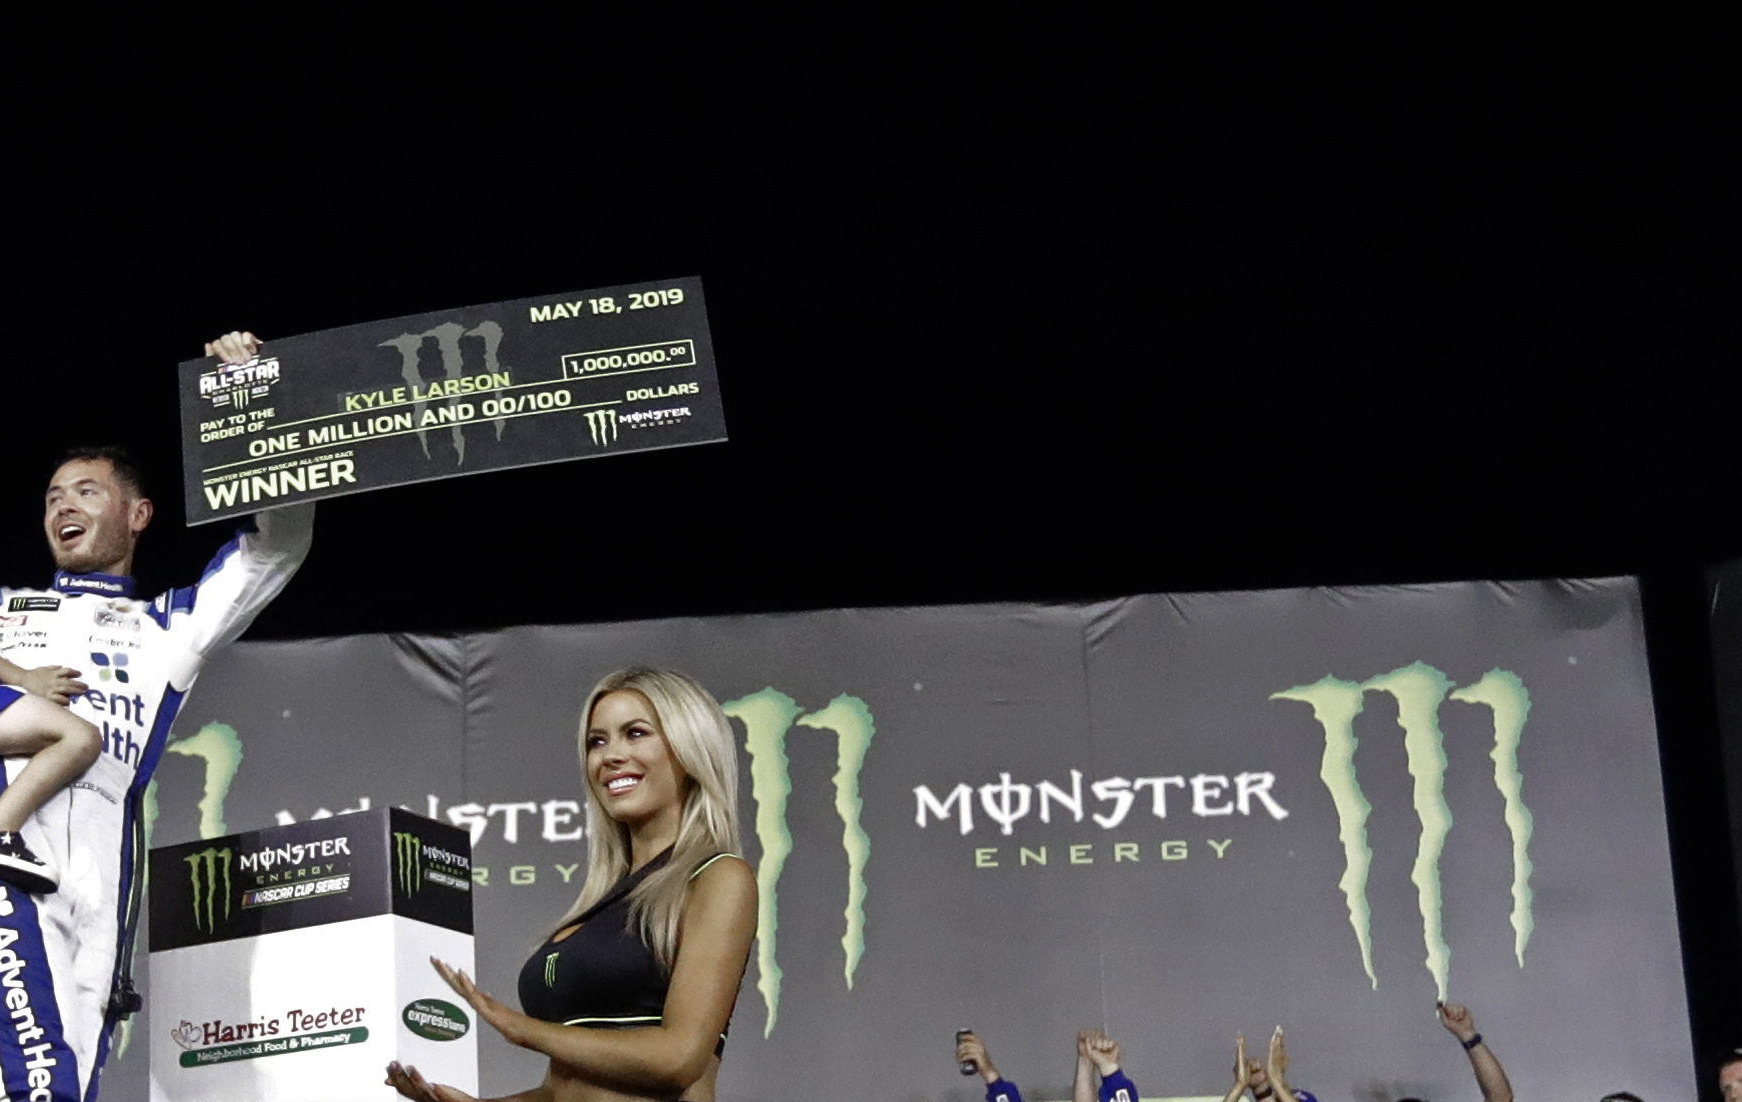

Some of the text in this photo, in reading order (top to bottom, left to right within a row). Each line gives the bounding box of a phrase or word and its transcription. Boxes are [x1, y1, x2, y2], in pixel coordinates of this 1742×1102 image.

[529, 288, 684, 323] MAY 18, 2019
[200, 360, 280, 395] ALL-STAR
[345, 371, 510, 411] KYLE LARSON
[625, 382, 700, 402] DOLLARS
[200, 407, 275, 432] PAY TO THE
[200, 421, 266, 443] ORDER OF
[249, 390, 572, 457] ONE MILLION AND 00/100
[204, 459, 357, 510] WINNER
[912, 767, 1290, 836] MONSTER
[240, 837, 351, 872] MONSTER
[974, 838, 1234, 869] ENERGY
[254, 877, 350, 904] NASCAR CUP SERIES
[256, 863, 334, 885] ENERGY
[202, 1007, 366, 1045] Harris Teeter
[196, 1043, 262, 1063] Neighborhood
[263, 1040, 288, 1053] Food
[301, 1032, 351, 1048] Pharmacy
